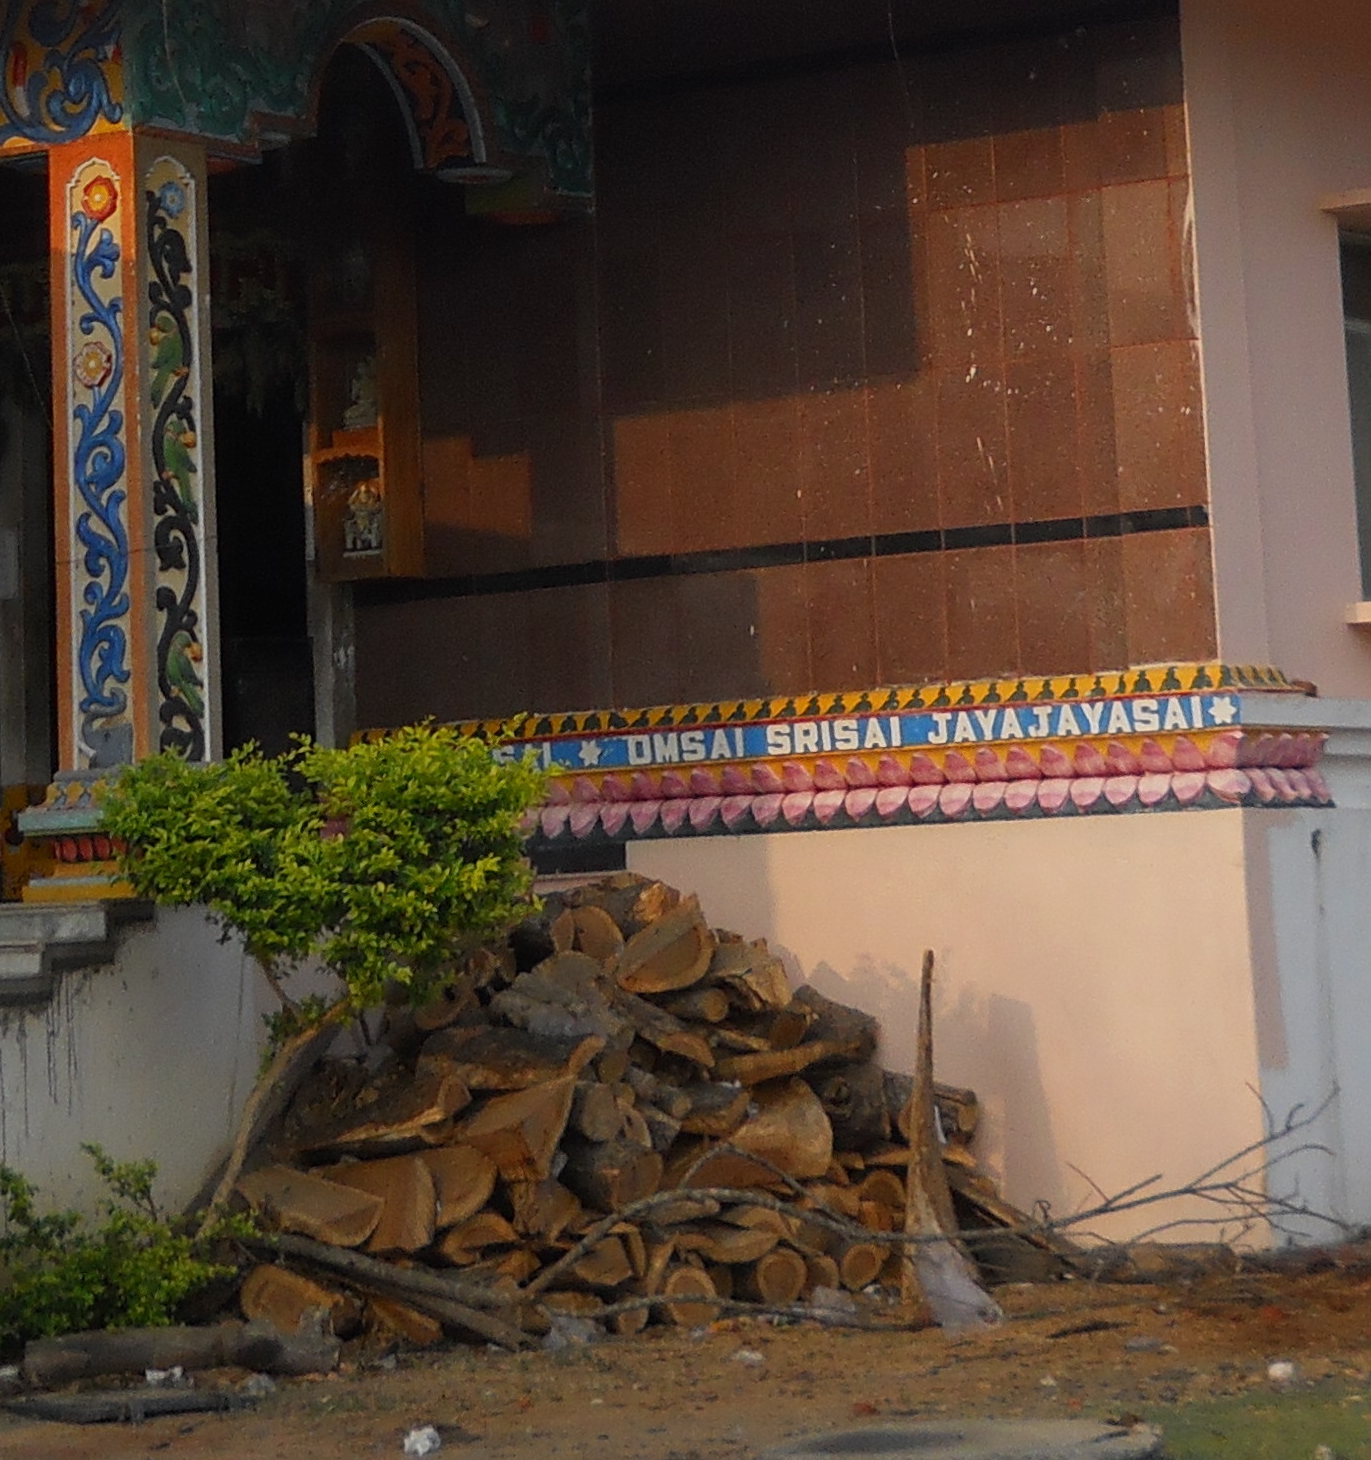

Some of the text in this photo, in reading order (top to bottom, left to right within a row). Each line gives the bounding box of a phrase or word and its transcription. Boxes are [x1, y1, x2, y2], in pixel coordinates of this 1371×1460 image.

[627, 726, 745, 766] OMSAI
[766, 715, 902, 756] SRISAI
[927, 695, 1204, 745] JAYAJAYASAI
